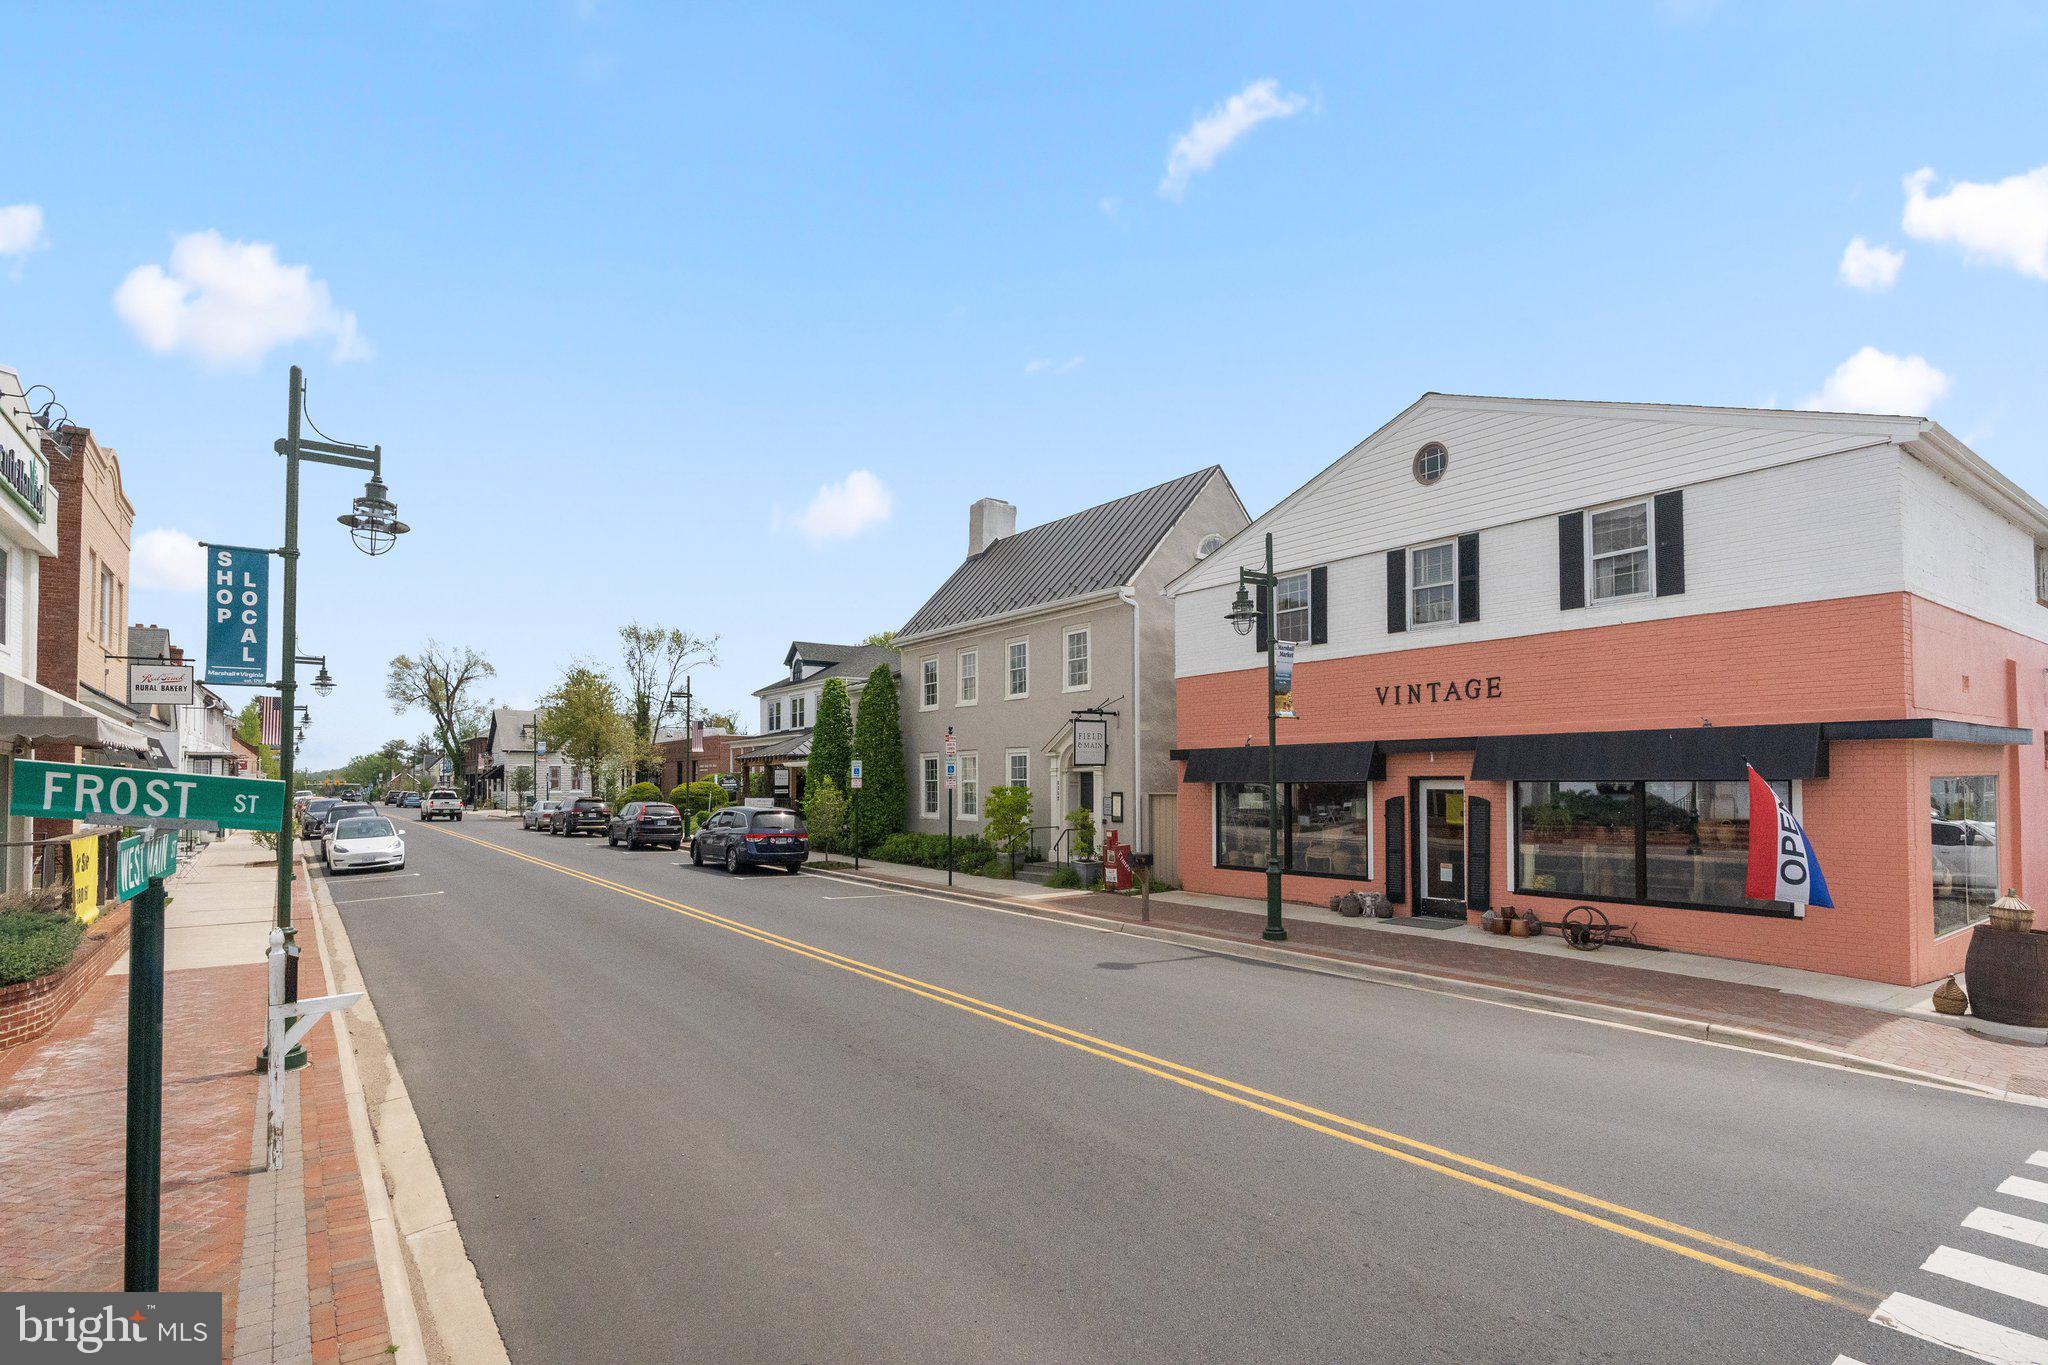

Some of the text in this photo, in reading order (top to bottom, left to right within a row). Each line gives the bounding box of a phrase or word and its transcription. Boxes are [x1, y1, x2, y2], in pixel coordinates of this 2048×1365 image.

[216, 551, 233, 624] SHOP
[240, 571, 258, 662] LOCAL
[135, 684, 188, 693] RURAL BAKERY
[207, 669, 264, 679] Marshall Virginia
[1375, 676, 1502, 706] VINTAGE
[1078, 732, 1103, 740] FIELD
[43, 771, 259, 819] FROST ST
[121, 842, 145, 893] WEST
[147, 834, 169, 877] MAIN
